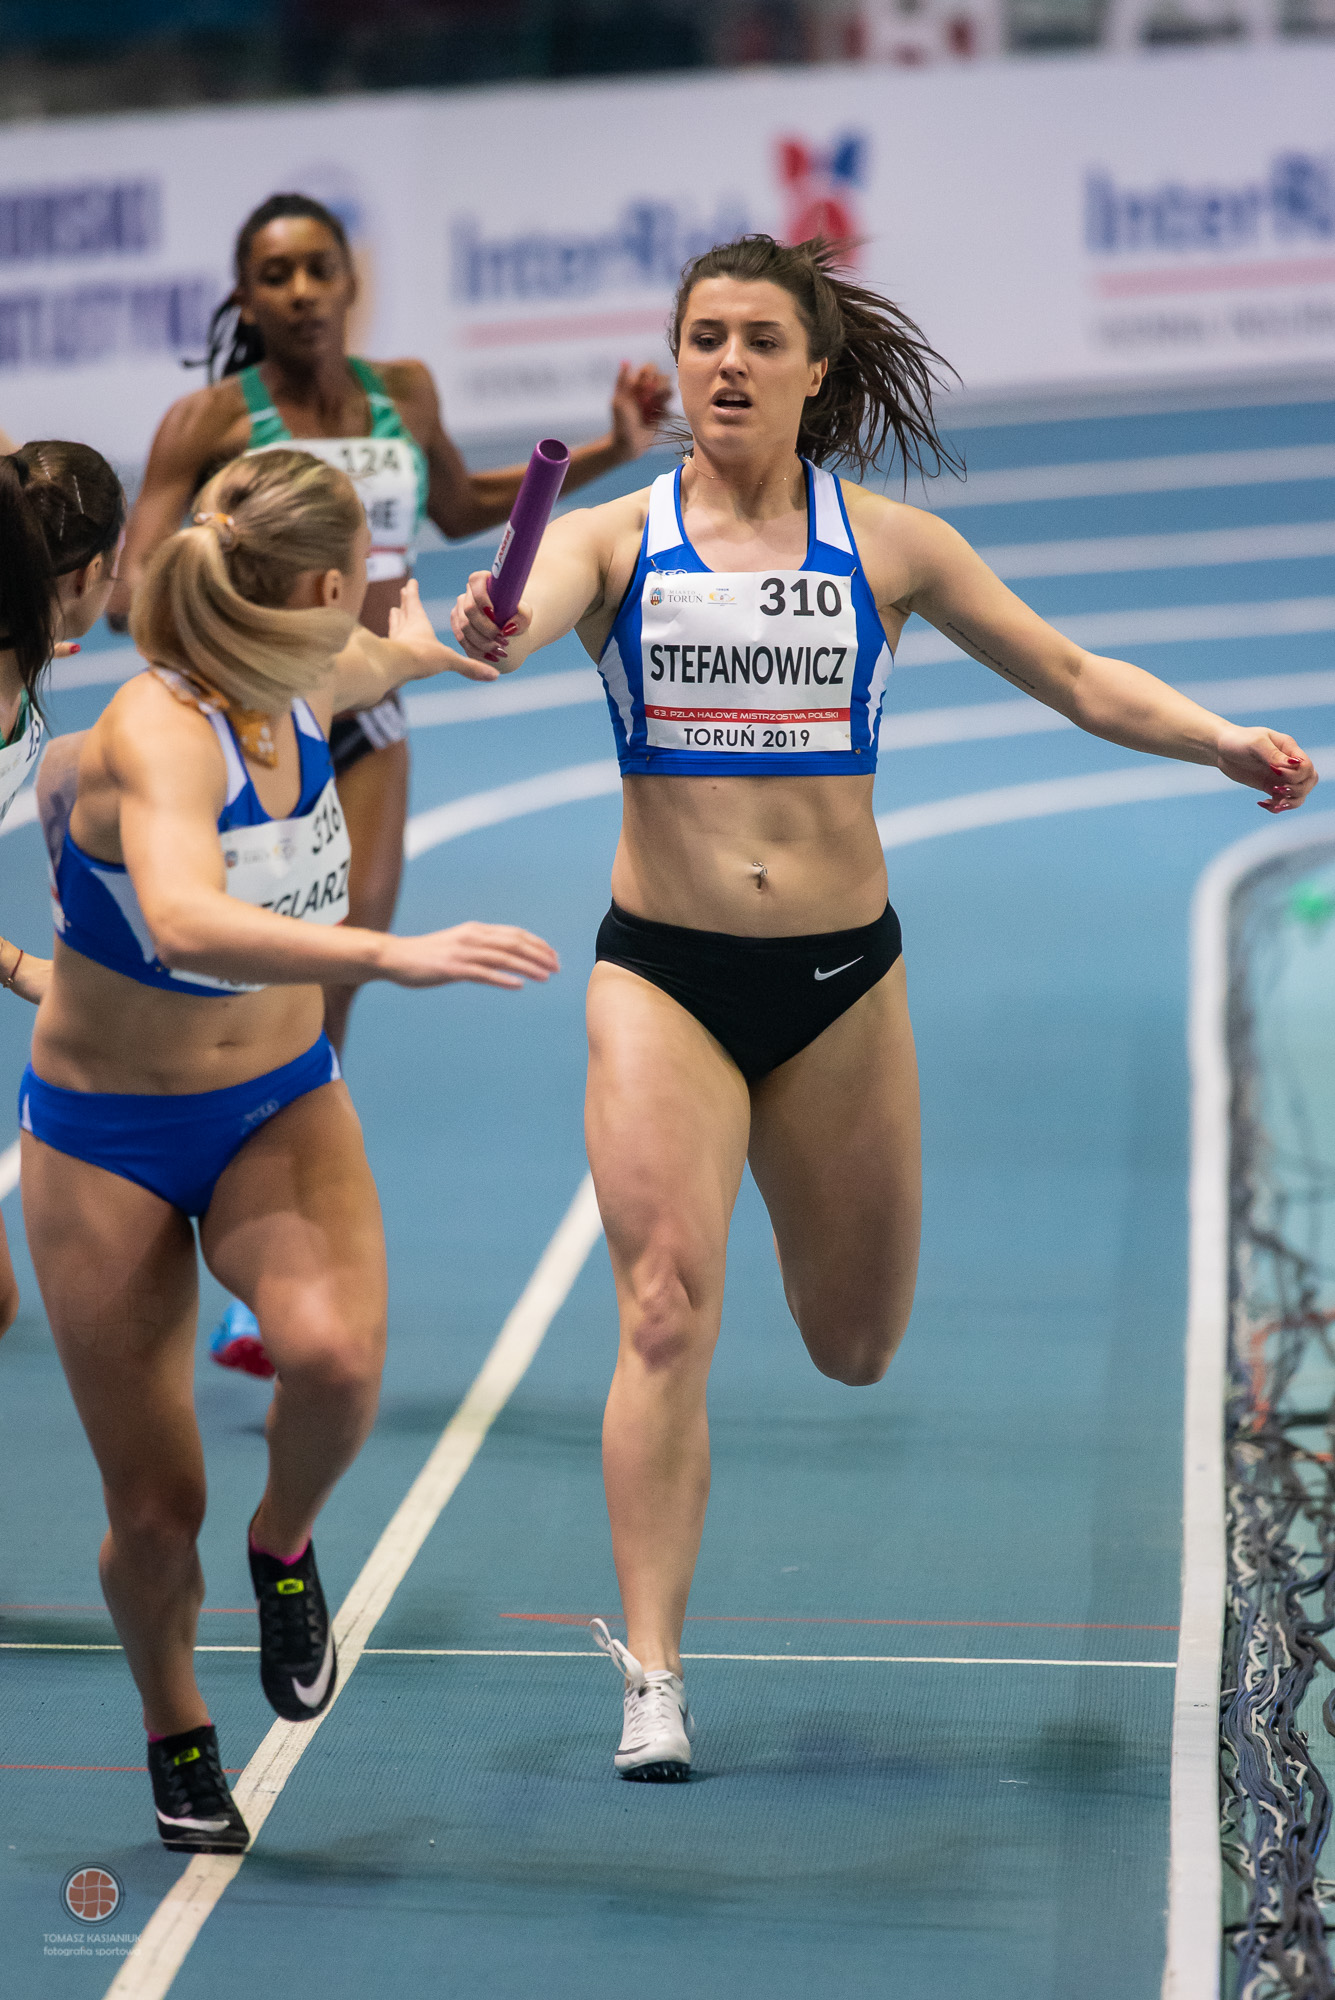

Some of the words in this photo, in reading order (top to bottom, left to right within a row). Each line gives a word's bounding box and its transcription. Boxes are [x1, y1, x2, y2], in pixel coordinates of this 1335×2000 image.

[759, 577, 842, 617] 310
[650, 643, 848, 685] STEFANOWICZ
[653, 709, 669, 717] 63.
[739, 712, 807, 721] MISTRZOSTWA
[808, 711, 839, 719] POLSKI
[684, 724, 755, 747] TORUŃ
[762, 729, 810, 747] 2019
